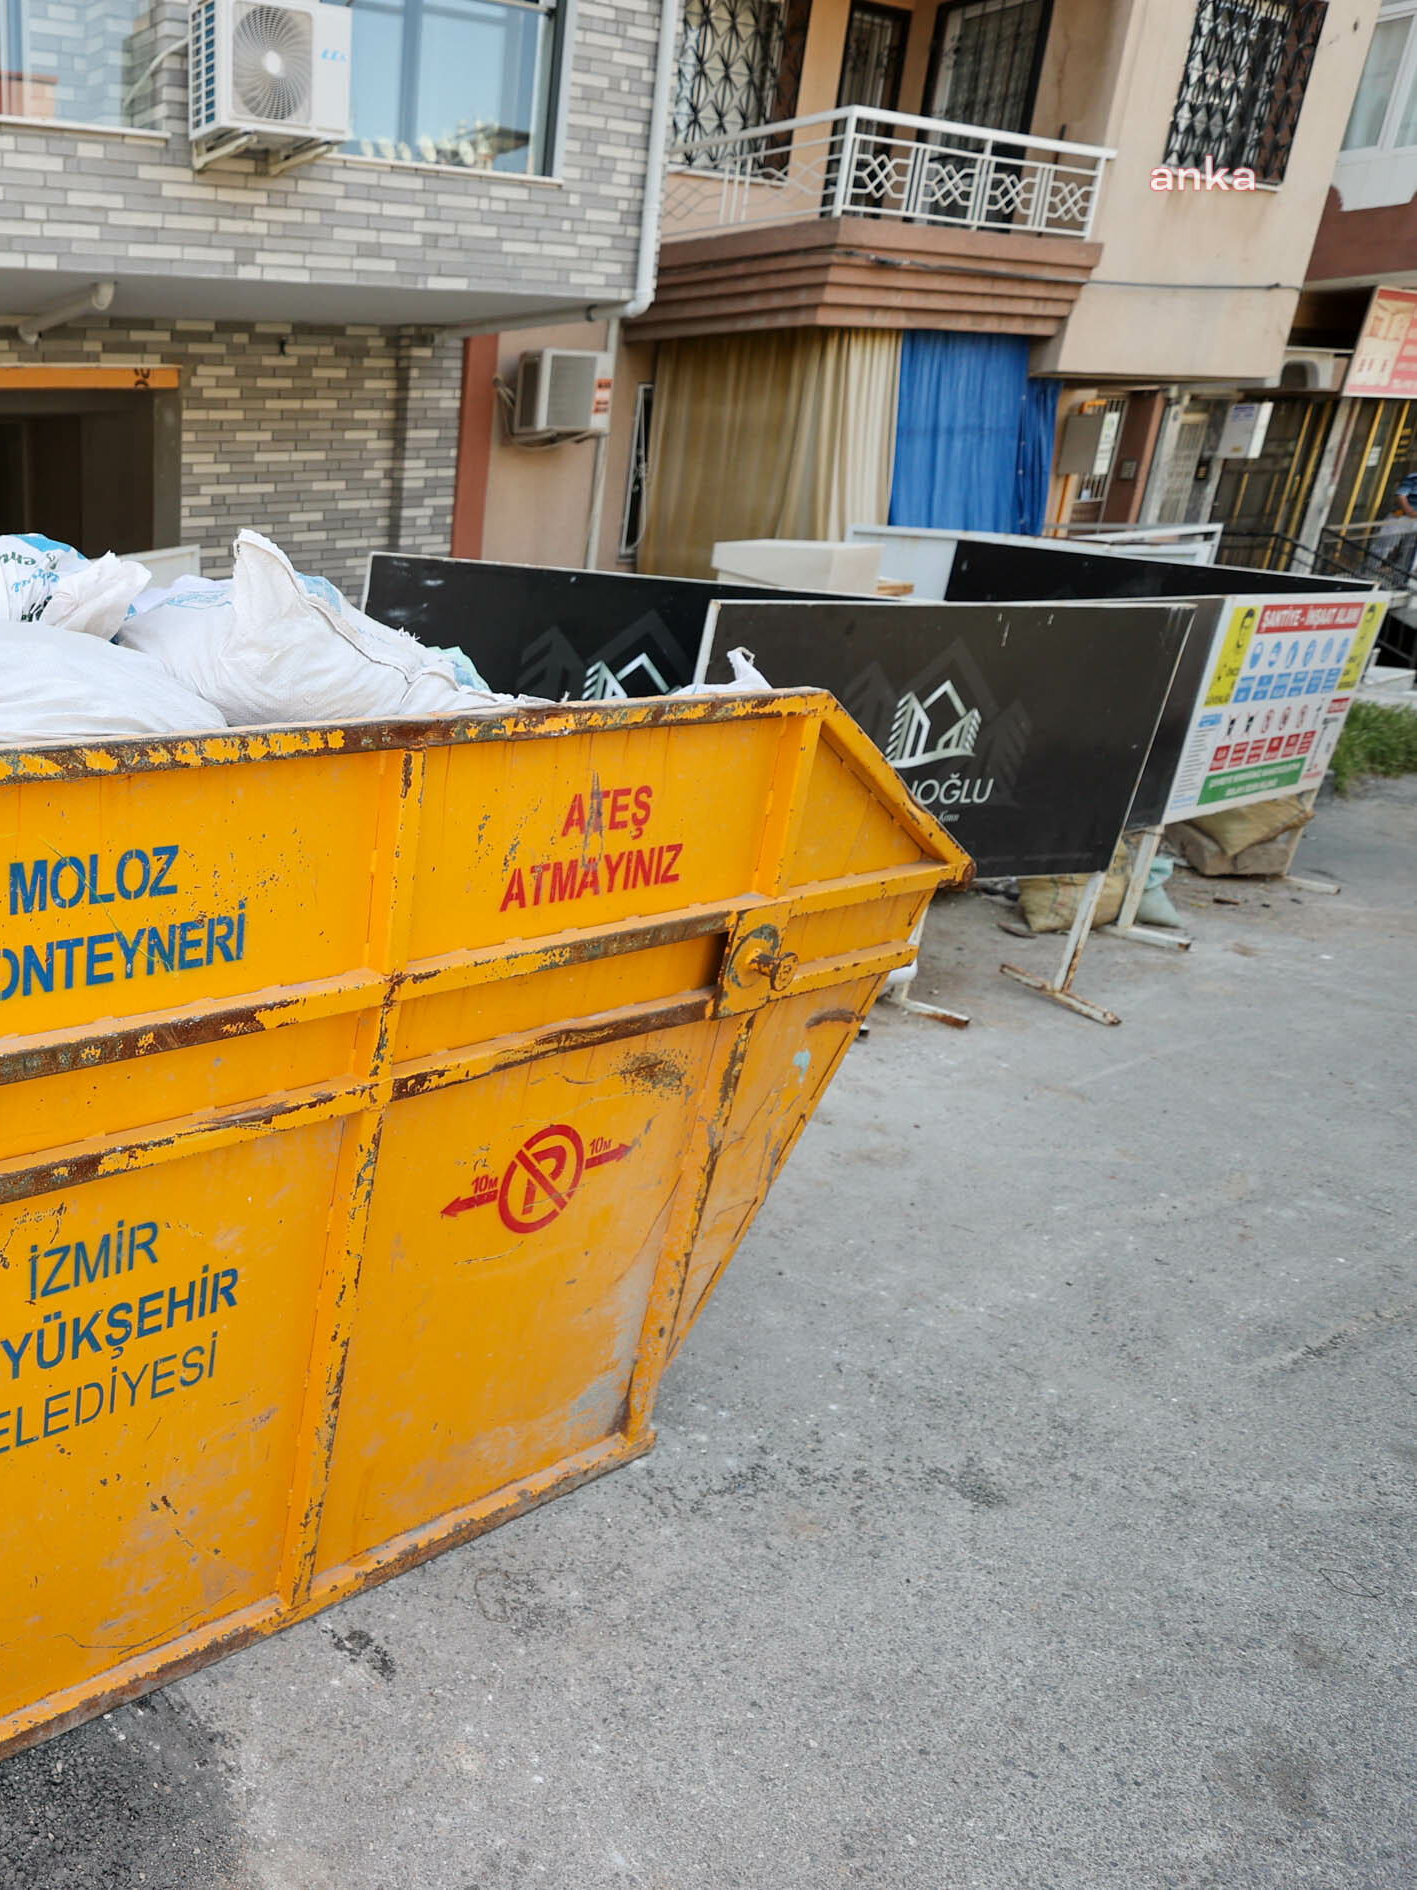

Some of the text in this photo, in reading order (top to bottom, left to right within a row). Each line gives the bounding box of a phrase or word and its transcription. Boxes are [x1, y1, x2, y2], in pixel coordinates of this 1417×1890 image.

[561, 785, 653, 841] ATEŞ
[9, 845, 179, 916] MOLOZ
[499, 843, 683, 912] ATMAYINIZ
[28, 1219, 159, 1301] İZMİR
